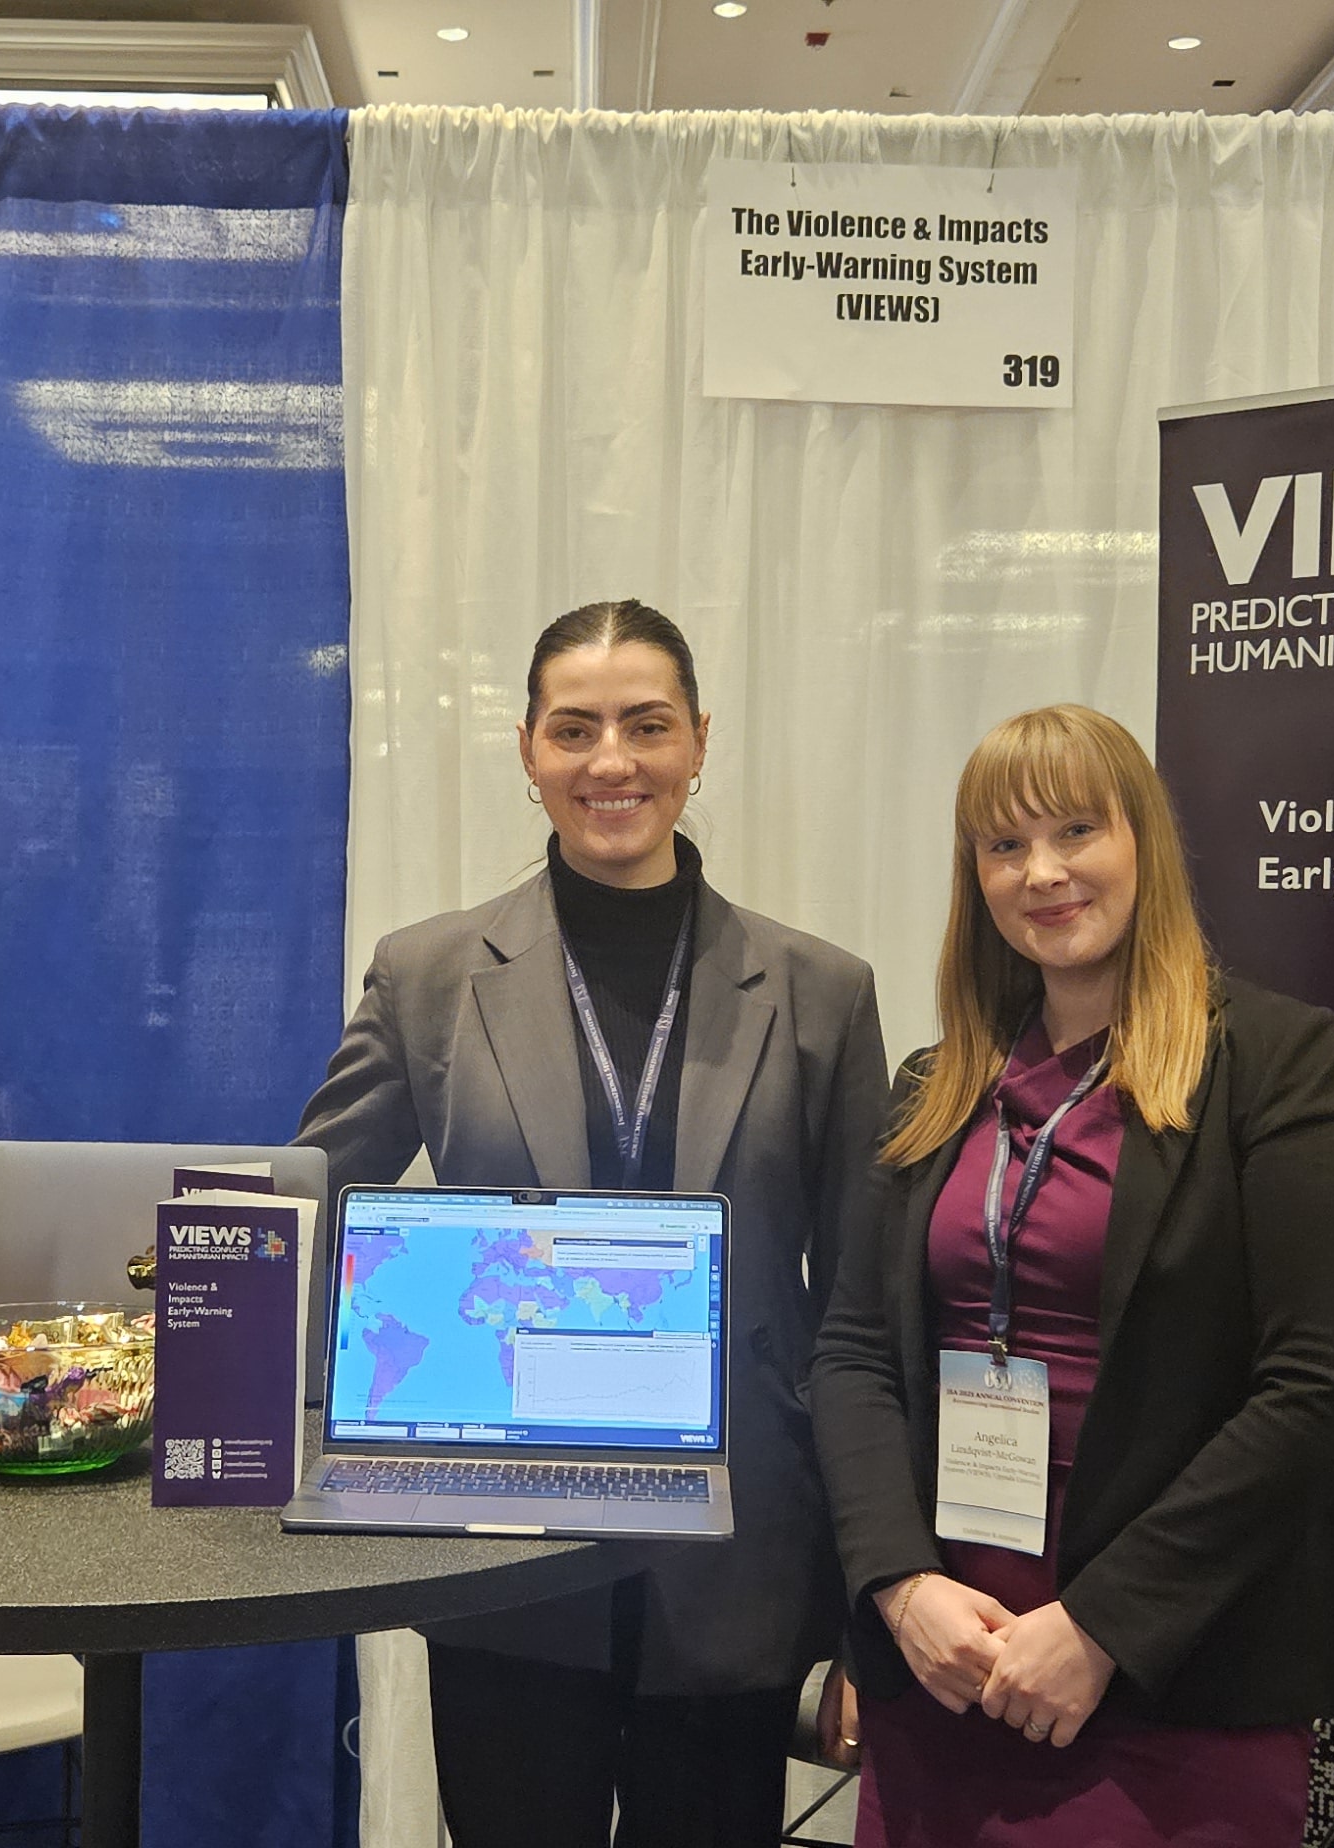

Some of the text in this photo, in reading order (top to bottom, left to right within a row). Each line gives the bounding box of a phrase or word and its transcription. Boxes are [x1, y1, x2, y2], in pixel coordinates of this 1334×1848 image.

[732, 208, 1048, 245] The Violence & Impacts
[742, 250, 1037, 285] Early-Warning System
[837, 294, 939, 322] (VIEWS)
[1004, 355, 1059, 387] 319
[169, 1225, 252, 1246] VIEWS
[169, 1282, 218, 1291] Violence &
[168, 1294, 203, 1305] Impacts
[168, 1306, 233, 1318] Early-Warning
[167, 1318, 200, 1330] System
[974, 1431, 1017, 1446] Angelica
